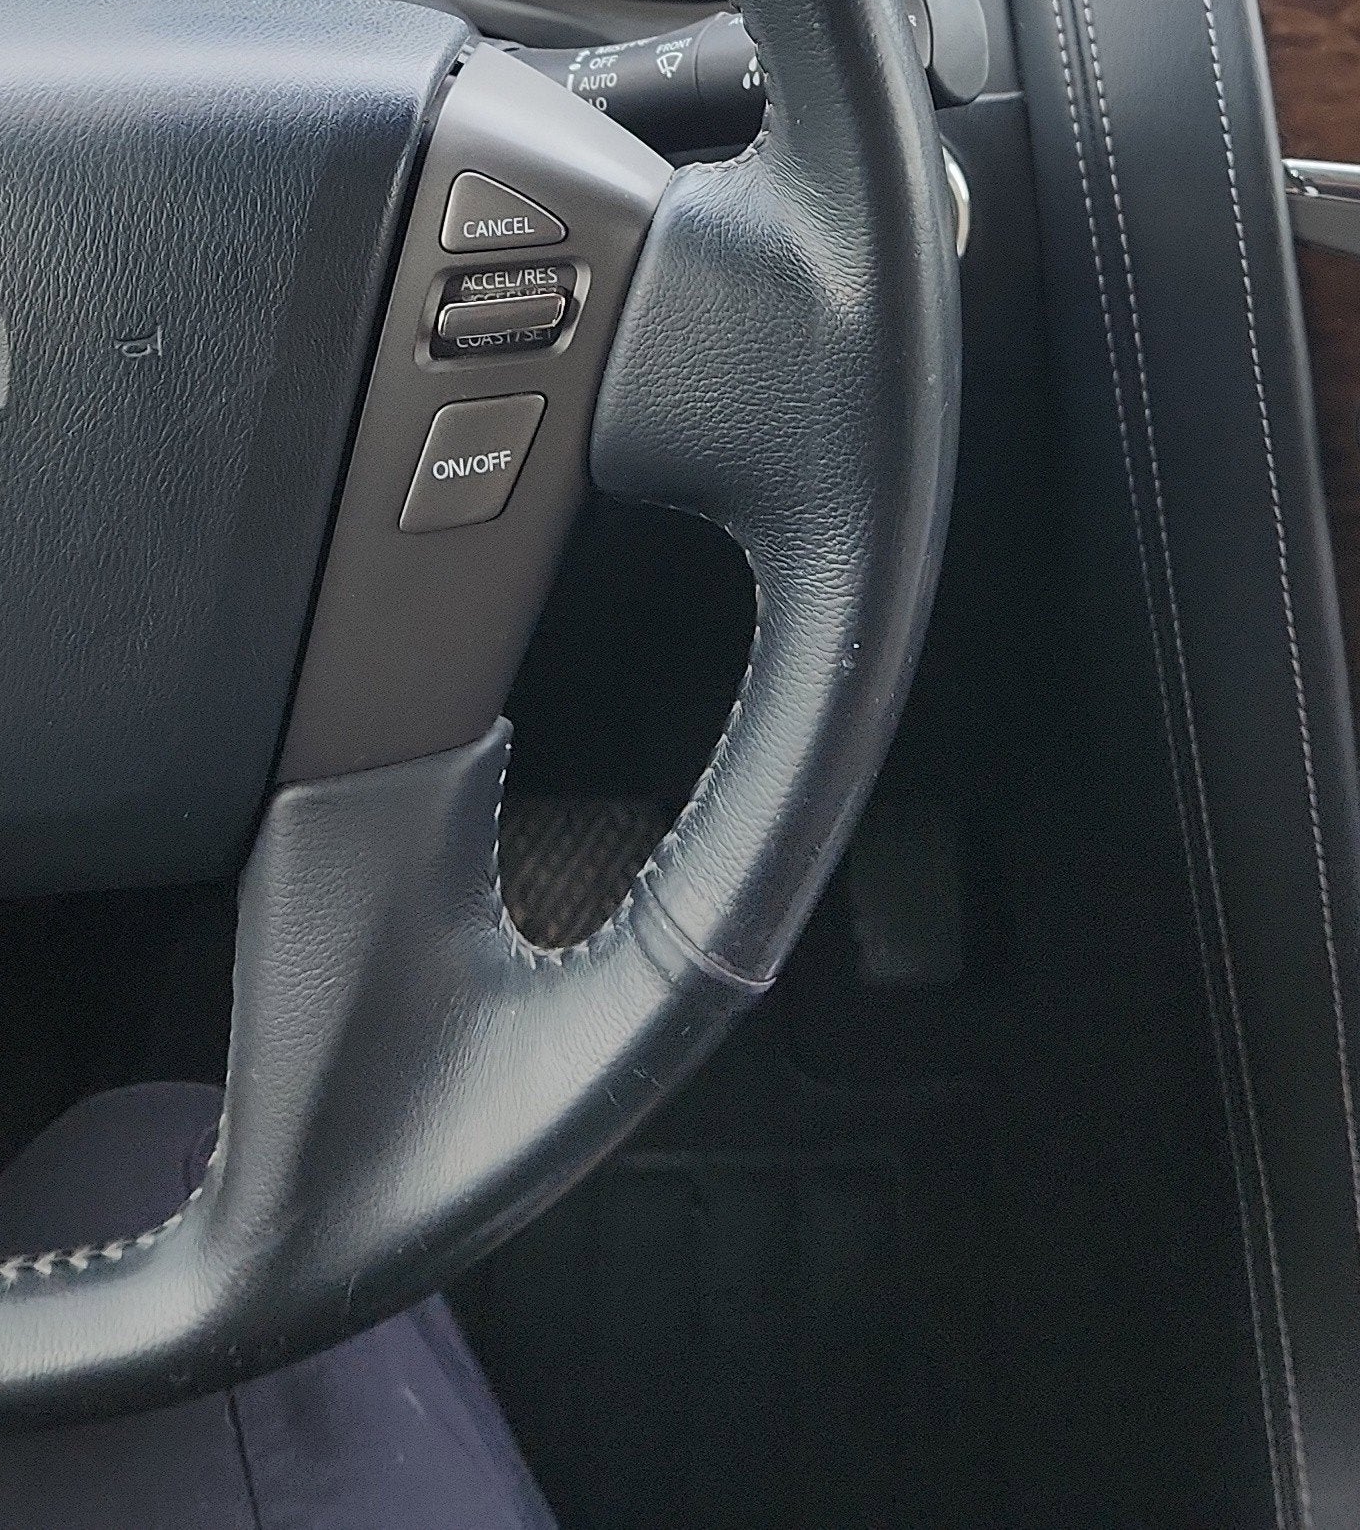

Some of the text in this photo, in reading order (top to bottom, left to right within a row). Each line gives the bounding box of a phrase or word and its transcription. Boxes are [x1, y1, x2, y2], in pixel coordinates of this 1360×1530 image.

[655, 37, 693, 55] FRONT
[589, 54, 620, 71] OFF
[577, 72, 619, 92] AUTO
[462, 216, 535, 238] CANCEL
[460, 266, 558, 292] ACCEL/RES
[431, 449, 512, 481] ON/OFF
